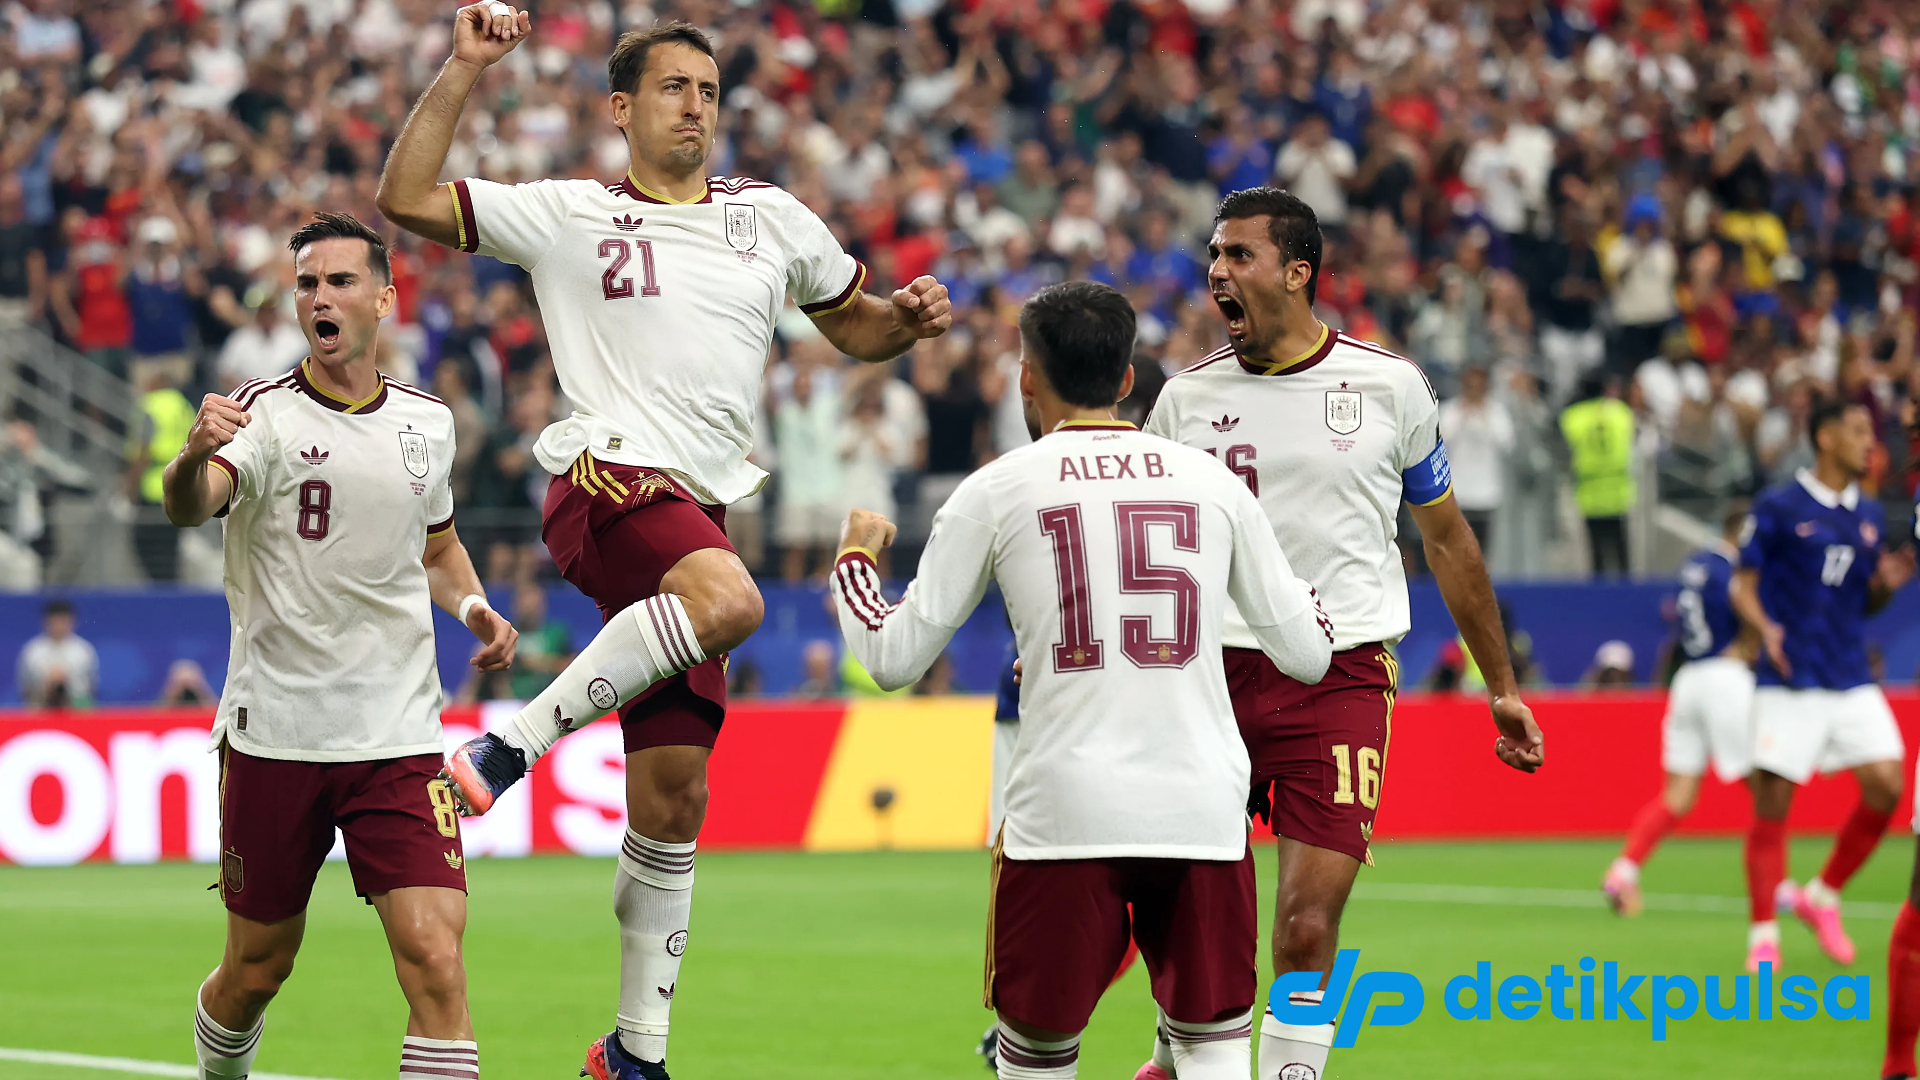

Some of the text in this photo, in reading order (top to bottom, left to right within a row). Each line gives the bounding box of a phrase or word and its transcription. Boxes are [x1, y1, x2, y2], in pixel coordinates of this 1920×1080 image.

[598, 239, 661, 300] 21
[1060, 453, 1173, 482] ALEX B.
[1203, 444, 1259, 499] 6
[296, 479, 332, 541] 8
[1037, 501, 1200, 674] 15
[1821, 544, 1855, 578] 17
[1331, 744, 1381, 811] 16
[426, 779, 457, 838] 8
